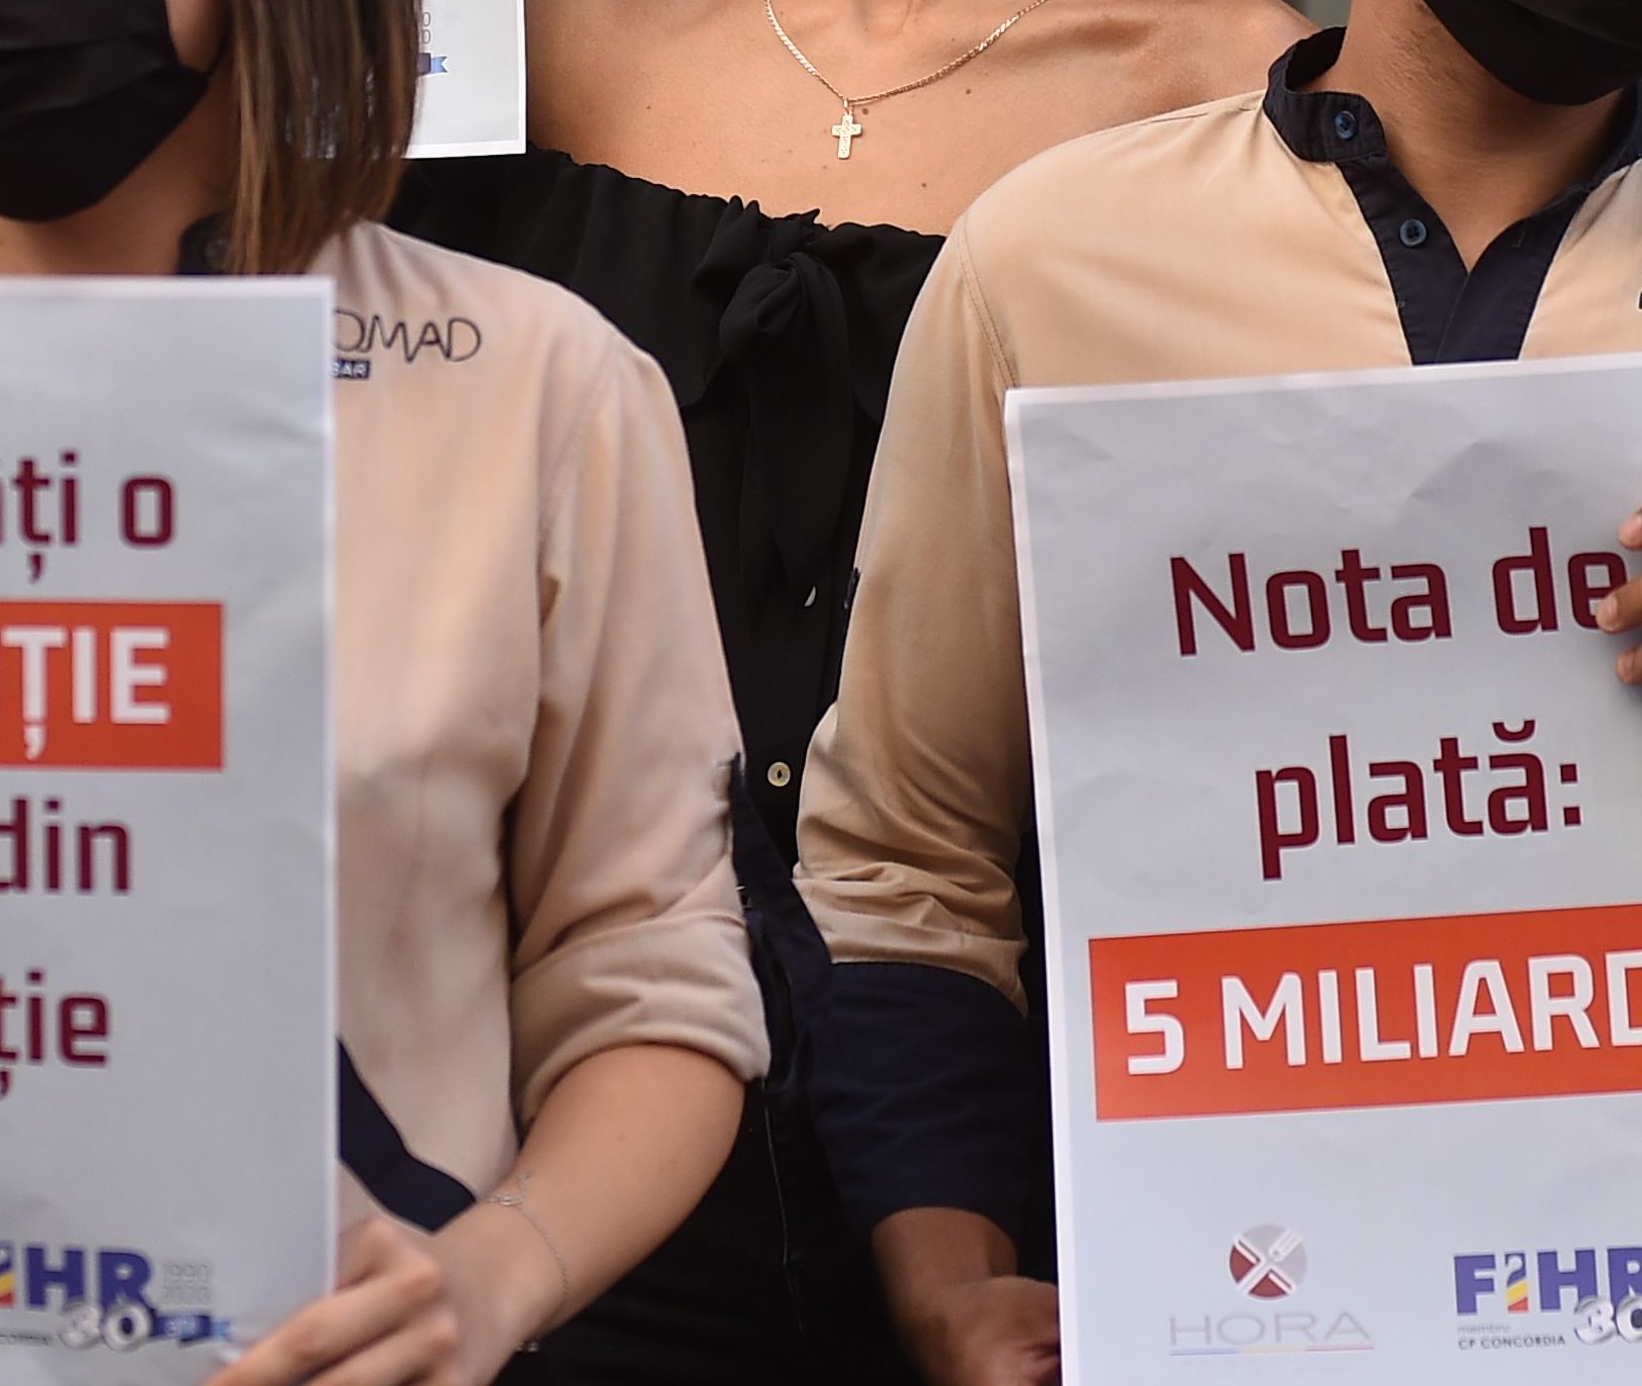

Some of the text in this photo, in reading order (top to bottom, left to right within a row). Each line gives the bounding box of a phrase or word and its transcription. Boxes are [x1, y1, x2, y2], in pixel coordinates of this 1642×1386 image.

[335, 308, 481, 362] OMAD
[122, 476, 175, 546] o
[1170, 527, 1628, 657] Nota de
[1255, 719, 1583, 880] plată:
[1125, 980, 1185, 1075] 5
[1169, 1311, 1371, 1346] HORA
[1481, 1334, 1566, 1349] CONCORDIA
